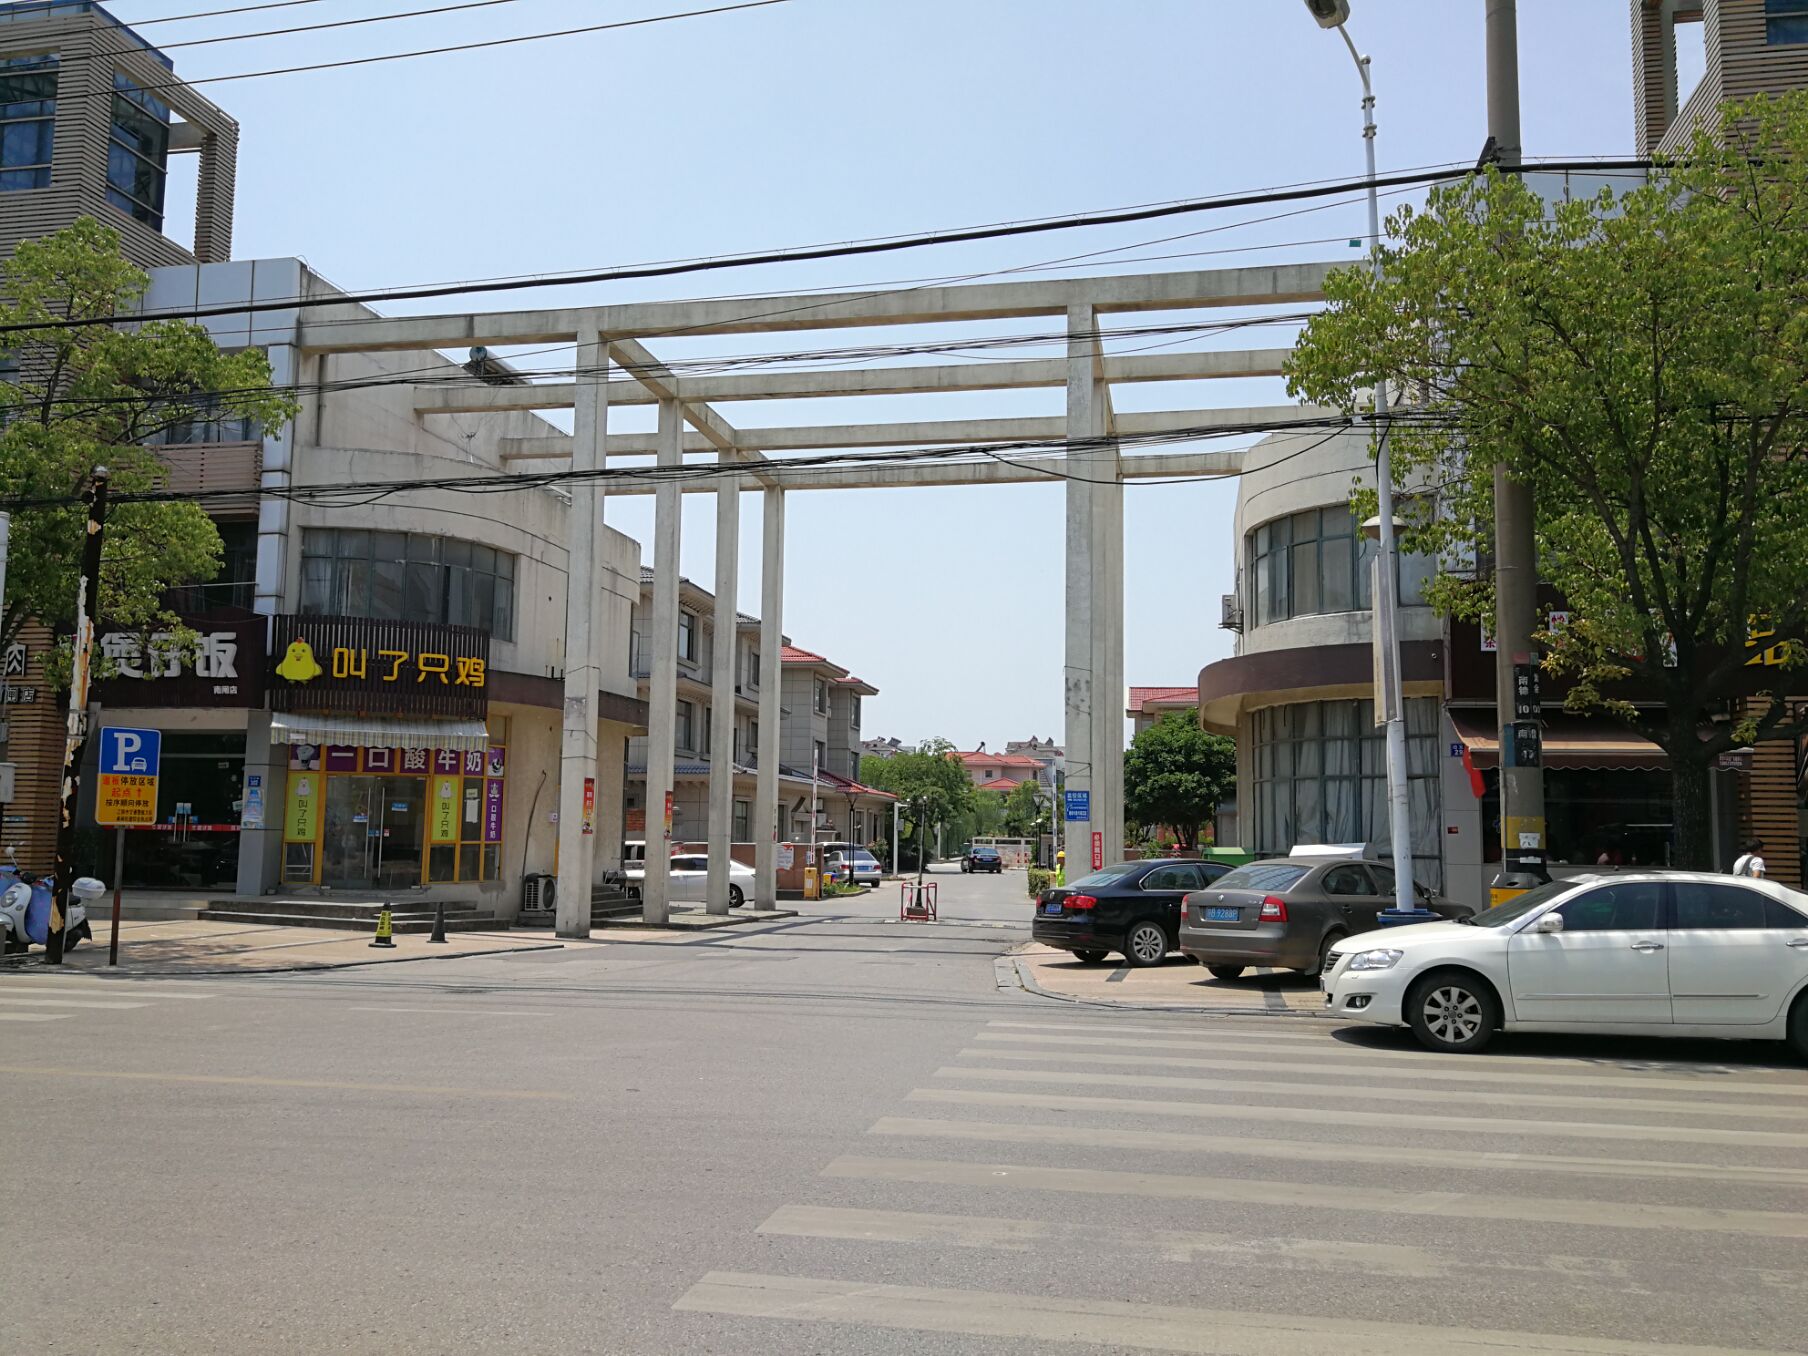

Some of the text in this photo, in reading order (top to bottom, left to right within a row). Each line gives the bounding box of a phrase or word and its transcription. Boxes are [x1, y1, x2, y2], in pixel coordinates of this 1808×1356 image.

[333, 647, 485, 687] 叫了只鸡
[112, 732, 142, 771] P
[331, 747, 481, 772] 一口酸牛奶
[297, 800, 308, 836] 叫了只鸡
[441, 802, 450, 837] 叫了只鸡
